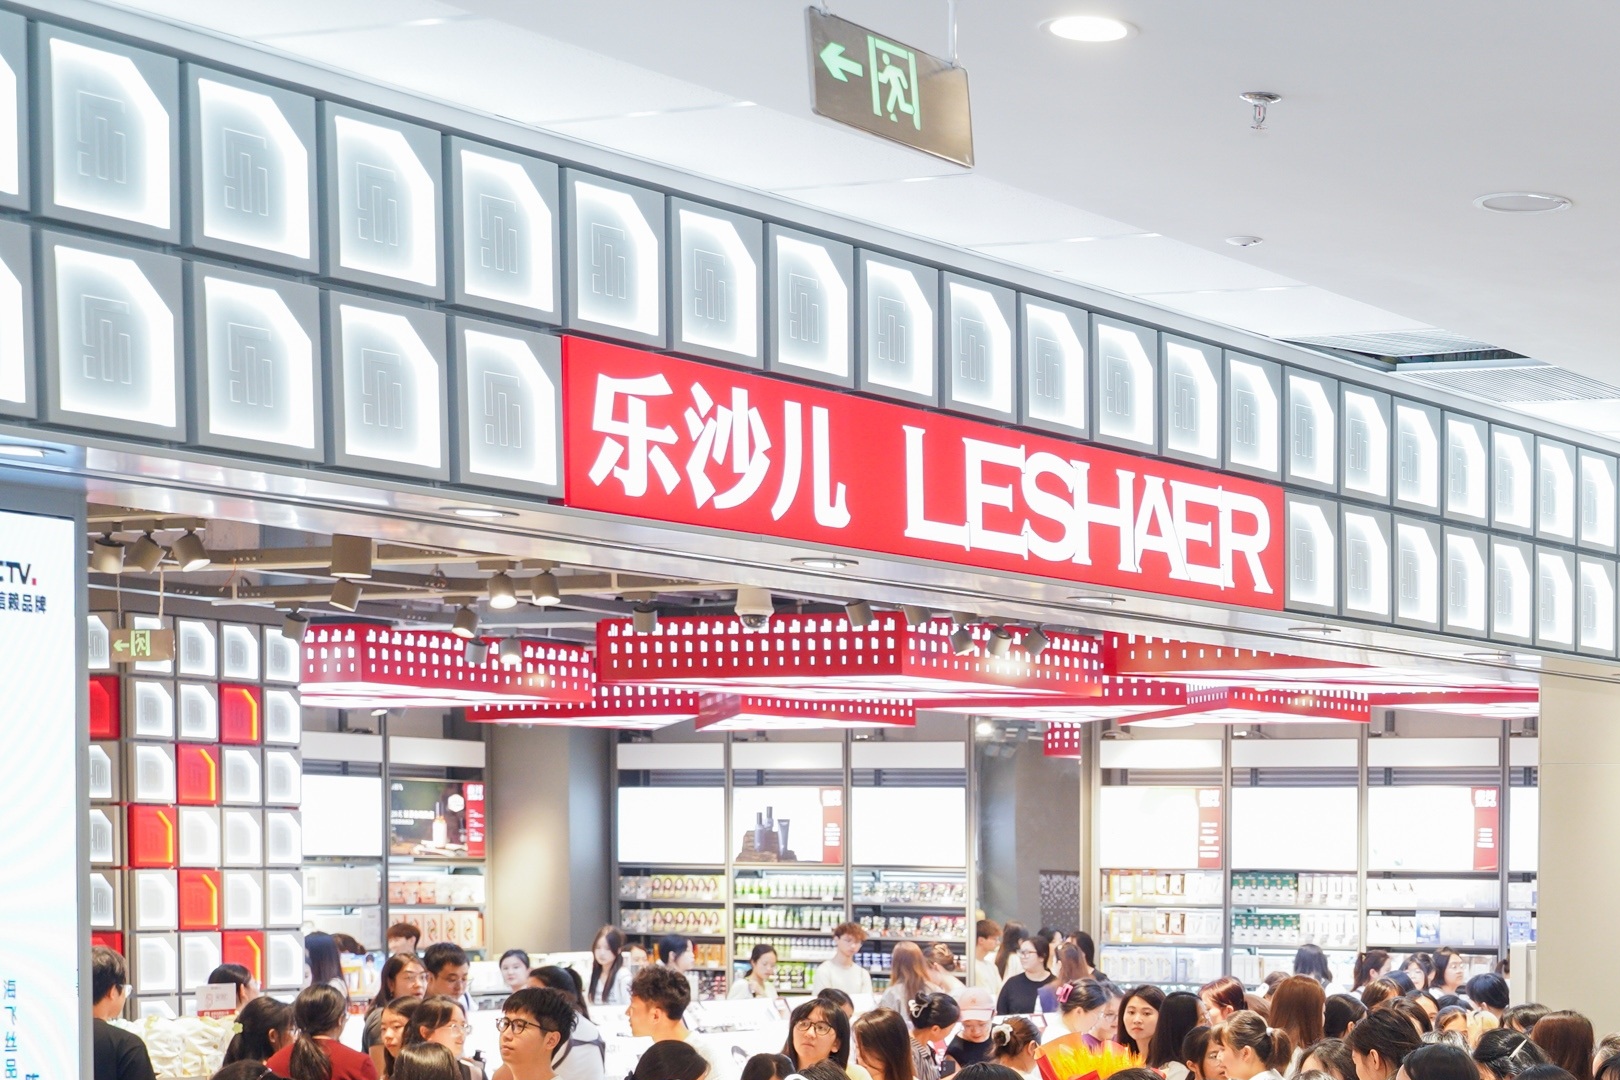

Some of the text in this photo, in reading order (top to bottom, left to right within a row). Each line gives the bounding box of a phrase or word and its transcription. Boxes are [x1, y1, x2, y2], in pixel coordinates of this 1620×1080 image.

[587, 371, 1275, 596] 乐沙儿 LESHAER
